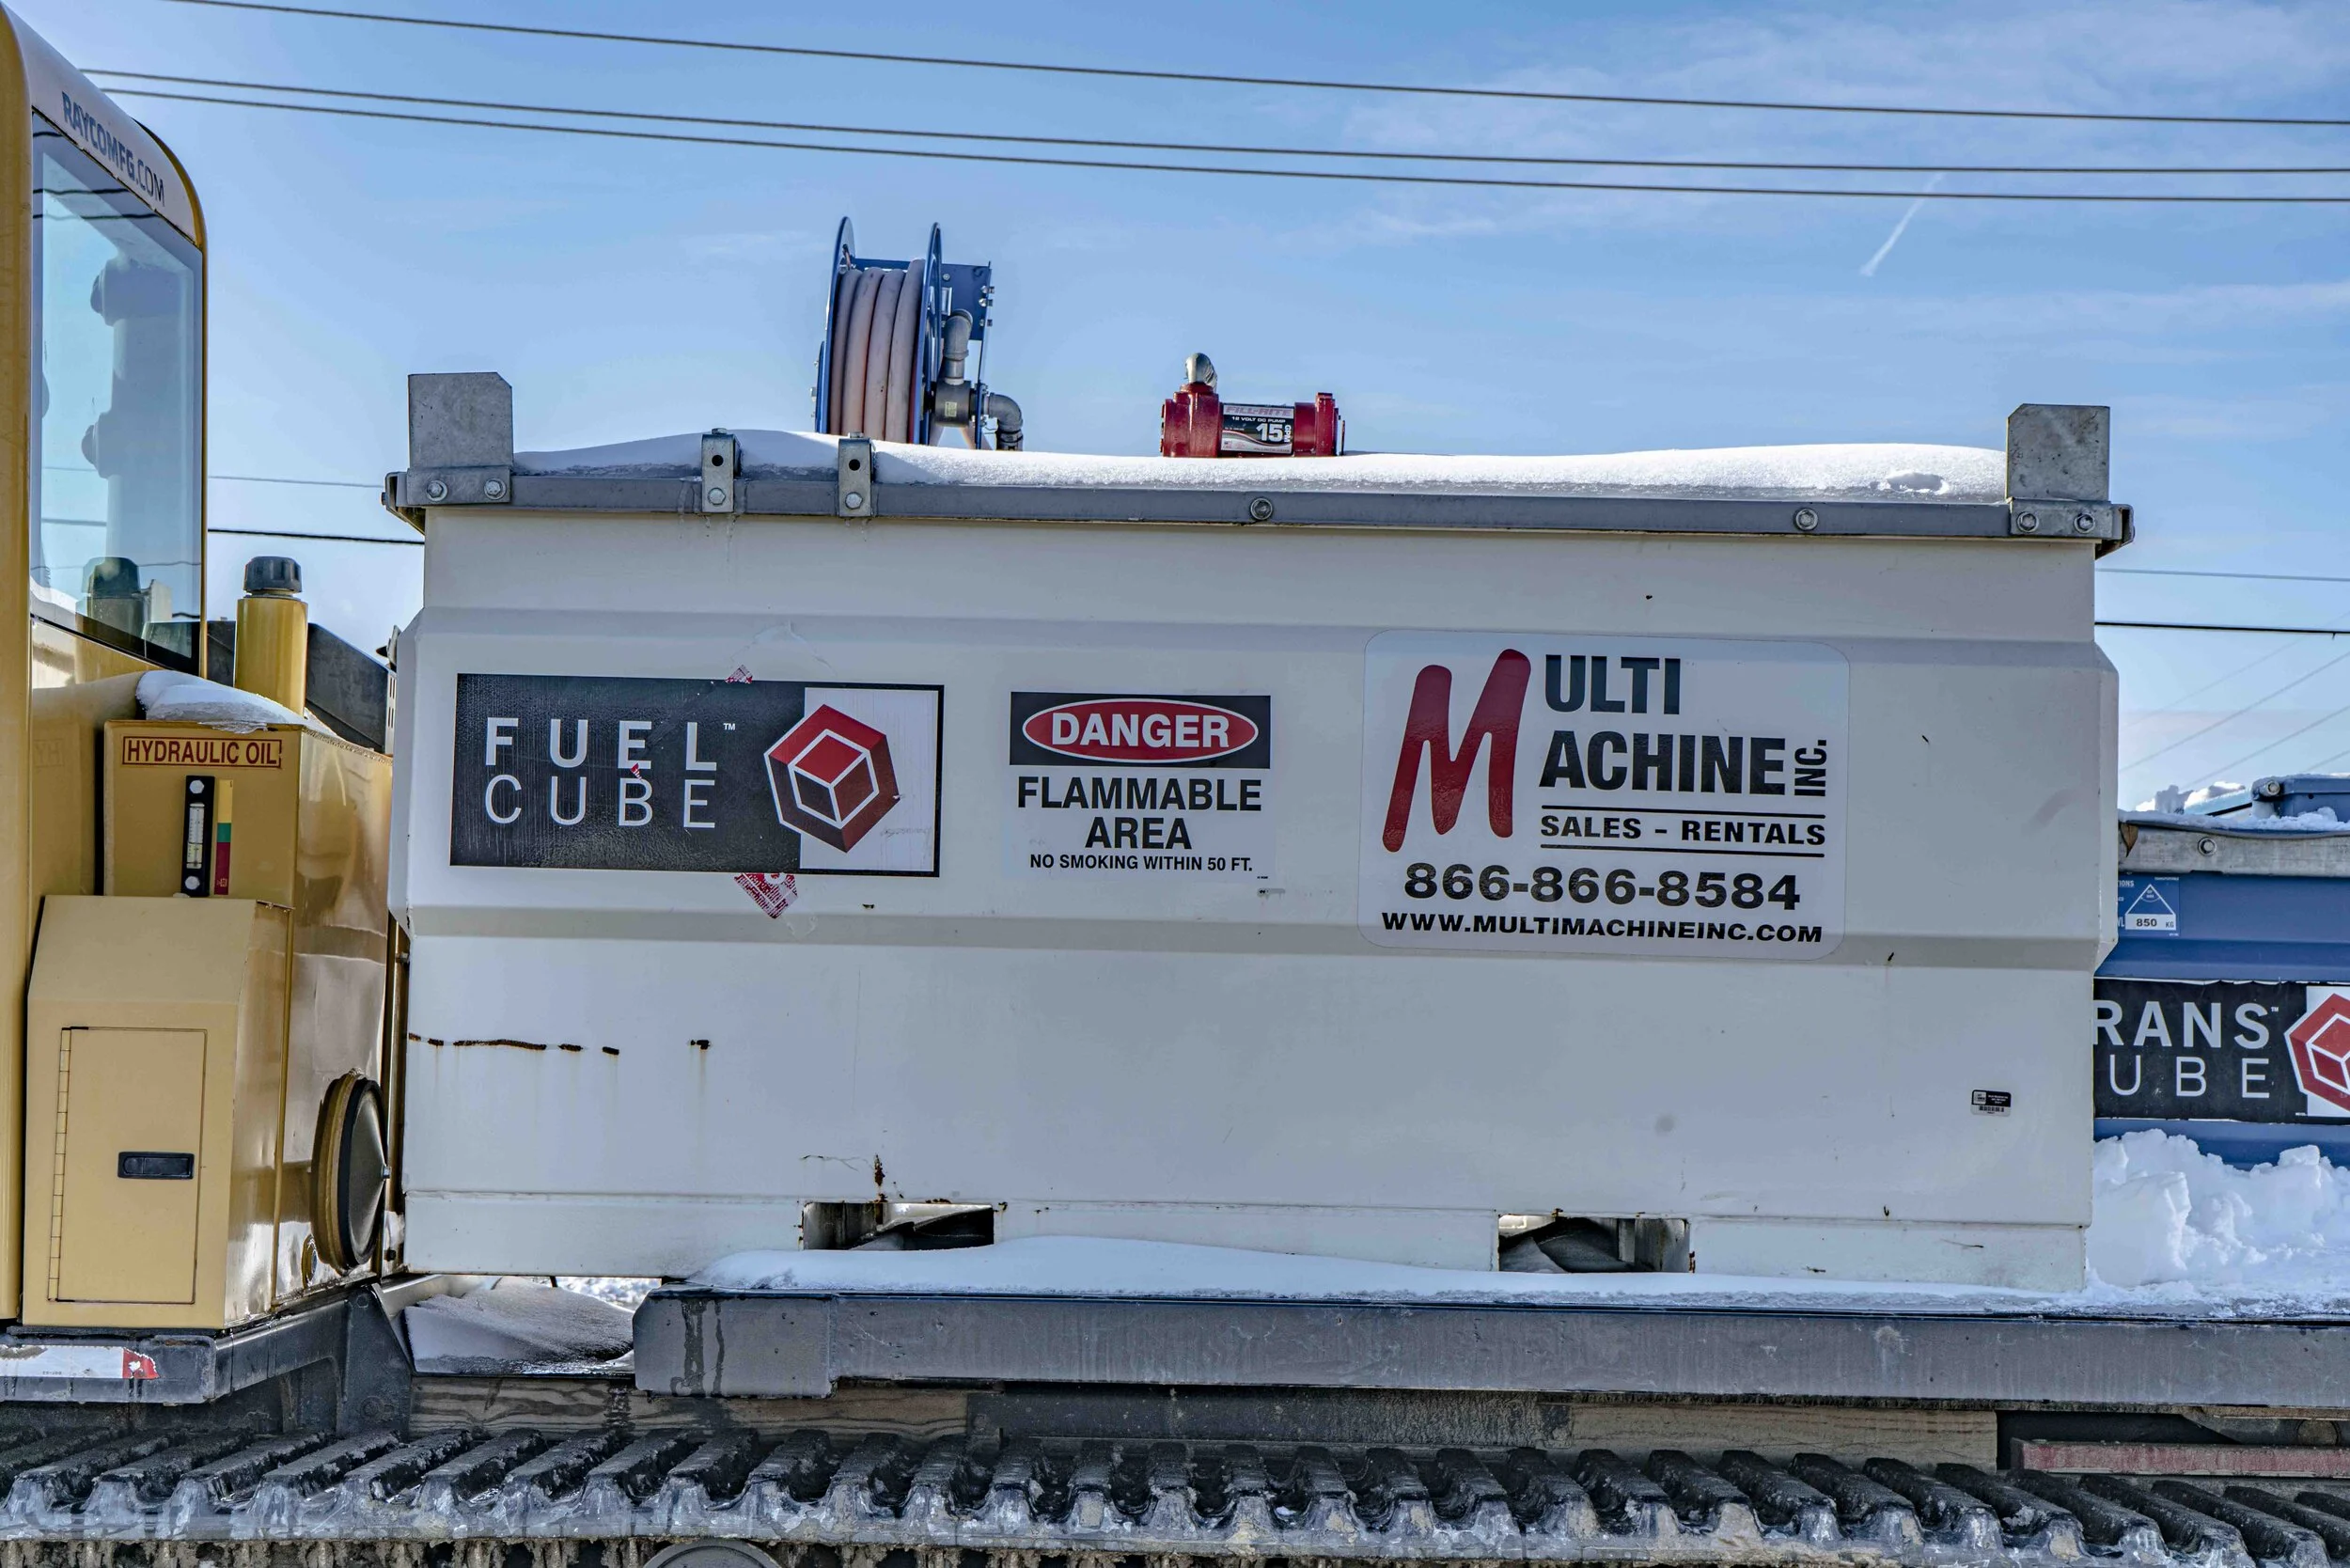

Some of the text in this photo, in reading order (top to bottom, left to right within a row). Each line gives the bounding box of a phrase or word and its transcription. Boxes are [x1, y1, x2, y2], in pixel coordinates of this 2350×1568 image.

[62, 90, 165, 207] RAYCOMFG.COM
[1256, 423, 1283, 442] 15
[485, 717, 717, 772] FUEL
[1052, 713, 1230, 748] DANGER
[127, 740, 277, 764] HYDRAULIC OIL
[1794, 739, 1827, 797] INC.
[484, 774, 715, 829] CUBE
[1018, 776, 1261, 811] FLAMMABLE
[1085, 817, 1192, 850] AREA
[1541, 815, 1641, 839] SALES
[1682, 820, 1825, 845] RENTALS
[1030, 855, 1253, 871] NO SMOKING WITHIN 50 FT.
[1404, 862, 1800, 911] 866-866-8584
[1382, 912, 1823, 943] WWW.MULTIMACHINEINC.COM
[2136, 918, 2157, 927] 850
[2093, 999, 2270, 1049] RANS
[2109, 1055, 2270, 1098] UBE
